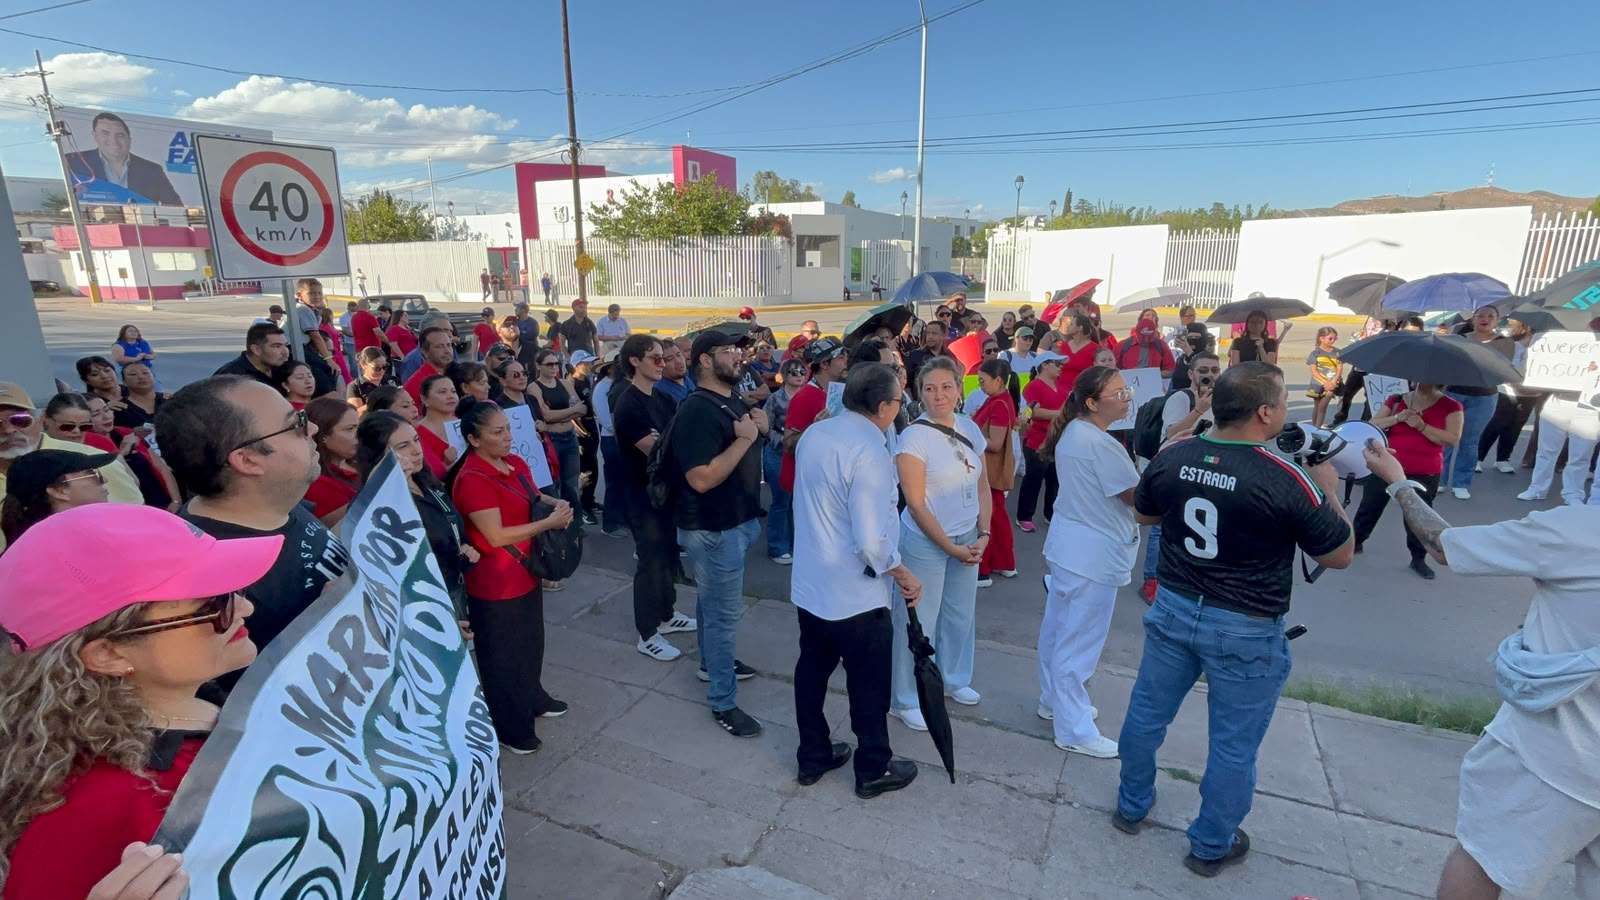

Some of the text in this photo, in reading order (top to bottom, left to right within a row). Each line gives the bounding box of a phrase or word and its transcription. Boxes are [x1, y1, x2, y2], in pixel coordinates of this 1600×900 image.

[249, 181, 309, 222] 40
[255, 226, 312, 241] km/h
[1179, 465, 1237, 491] ESTRADA
[358, 506, 422, 585] POR
[1184, 497, 1218, 559] 9
[434, 811, 459, 877] LA
